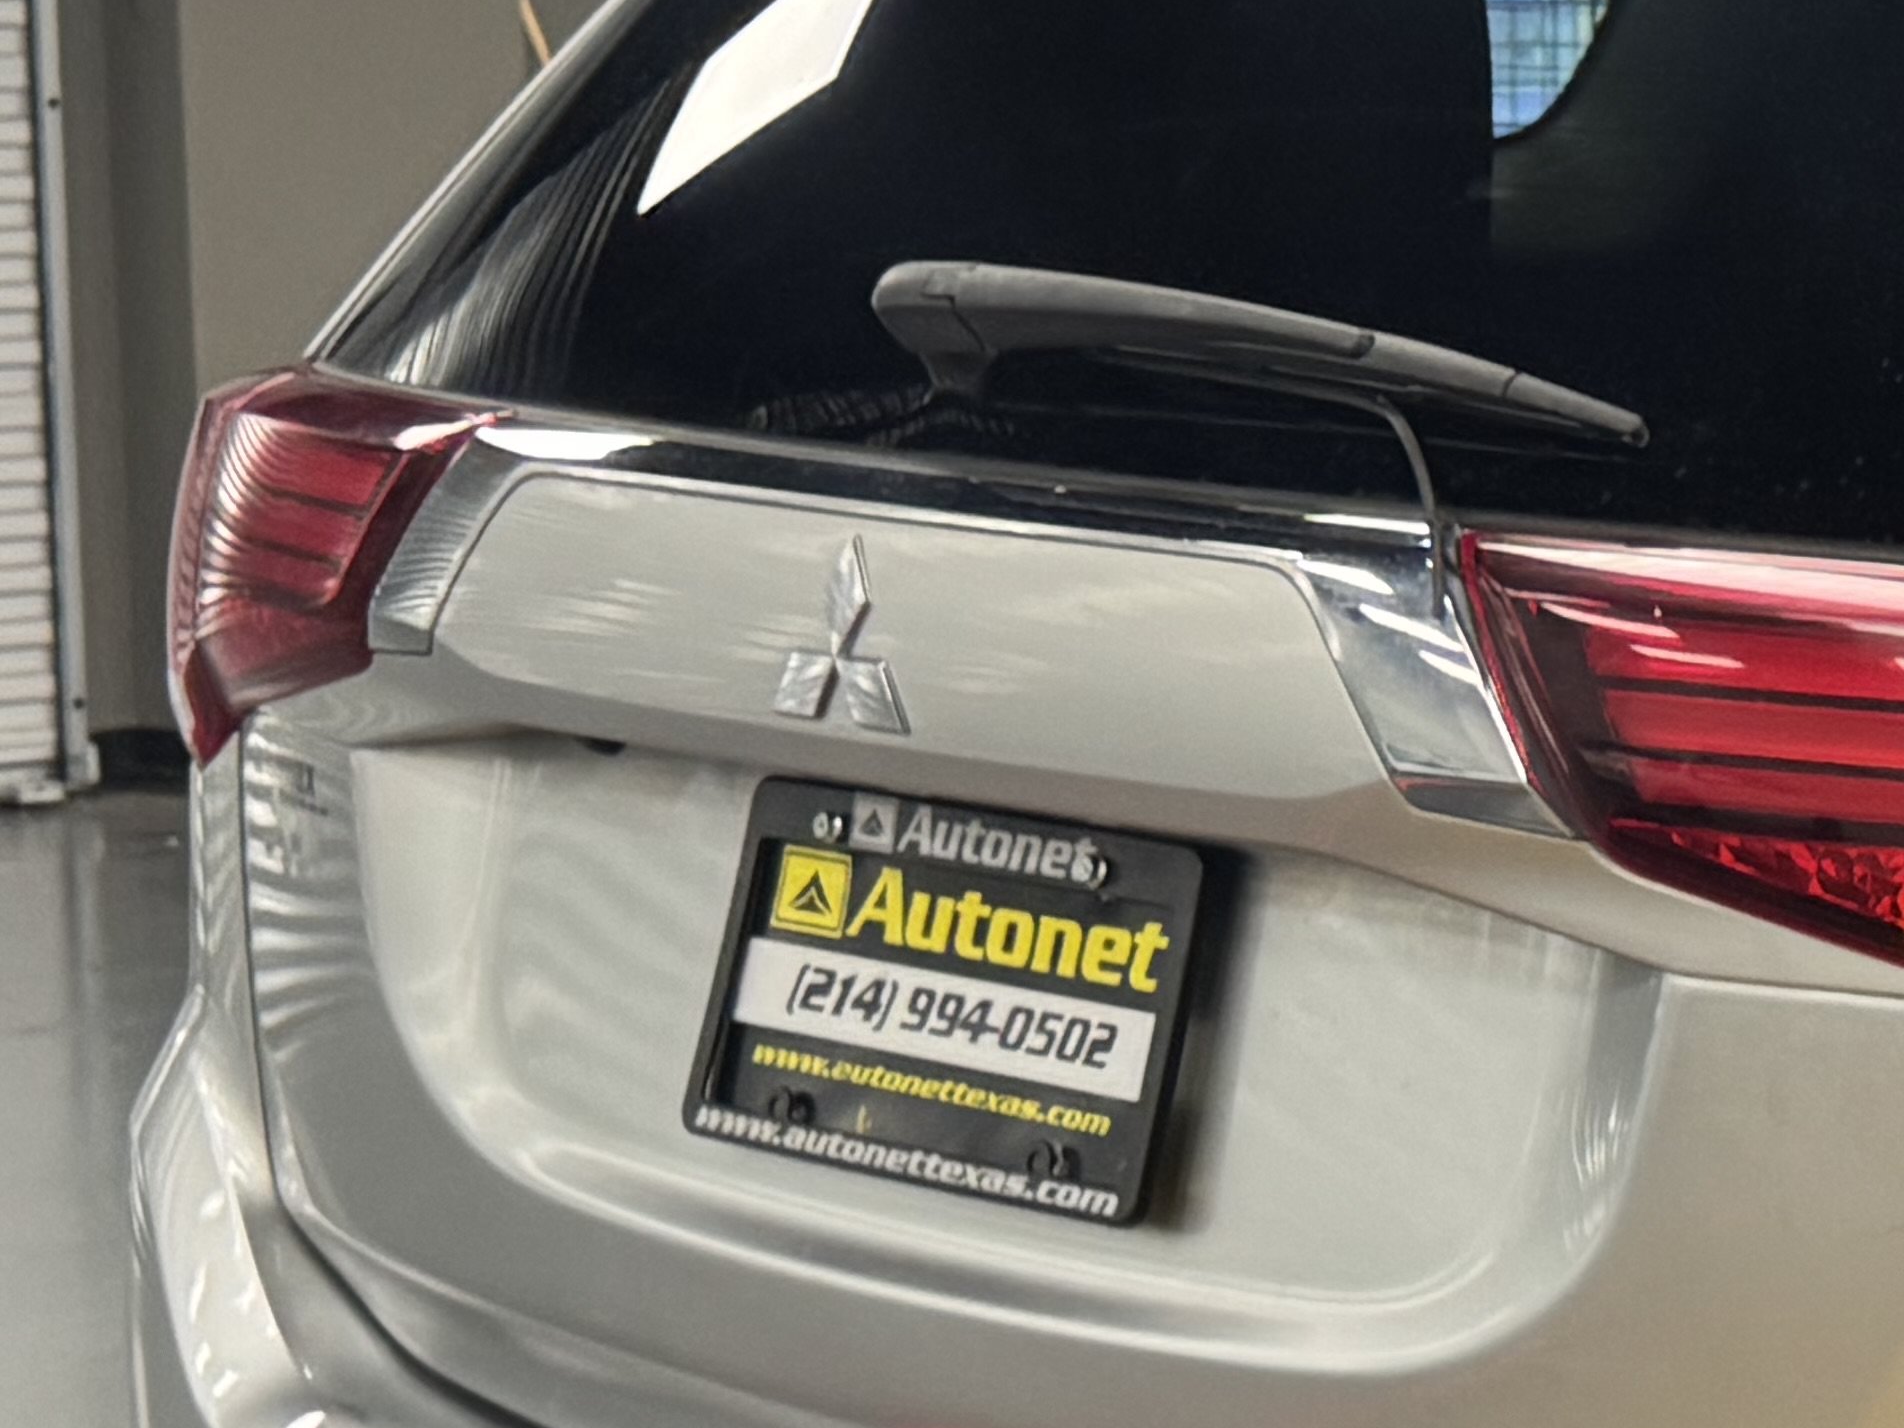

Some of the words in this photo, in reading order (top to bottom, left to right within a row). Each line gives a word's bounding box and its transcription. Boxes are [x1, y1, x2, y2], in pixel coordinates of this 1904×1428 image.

[897, 806, 1097, 884] Autonet
[845, 866, 1169, 993] Autonet
[786, 963, 898, 1032] (214)
[899, 986, 1117, 1070] 994-0502
[752, 1043, 1111, 1137] www.autonettexas.com
[695, 1103, 1119, 1218] www.autonettexas.com
